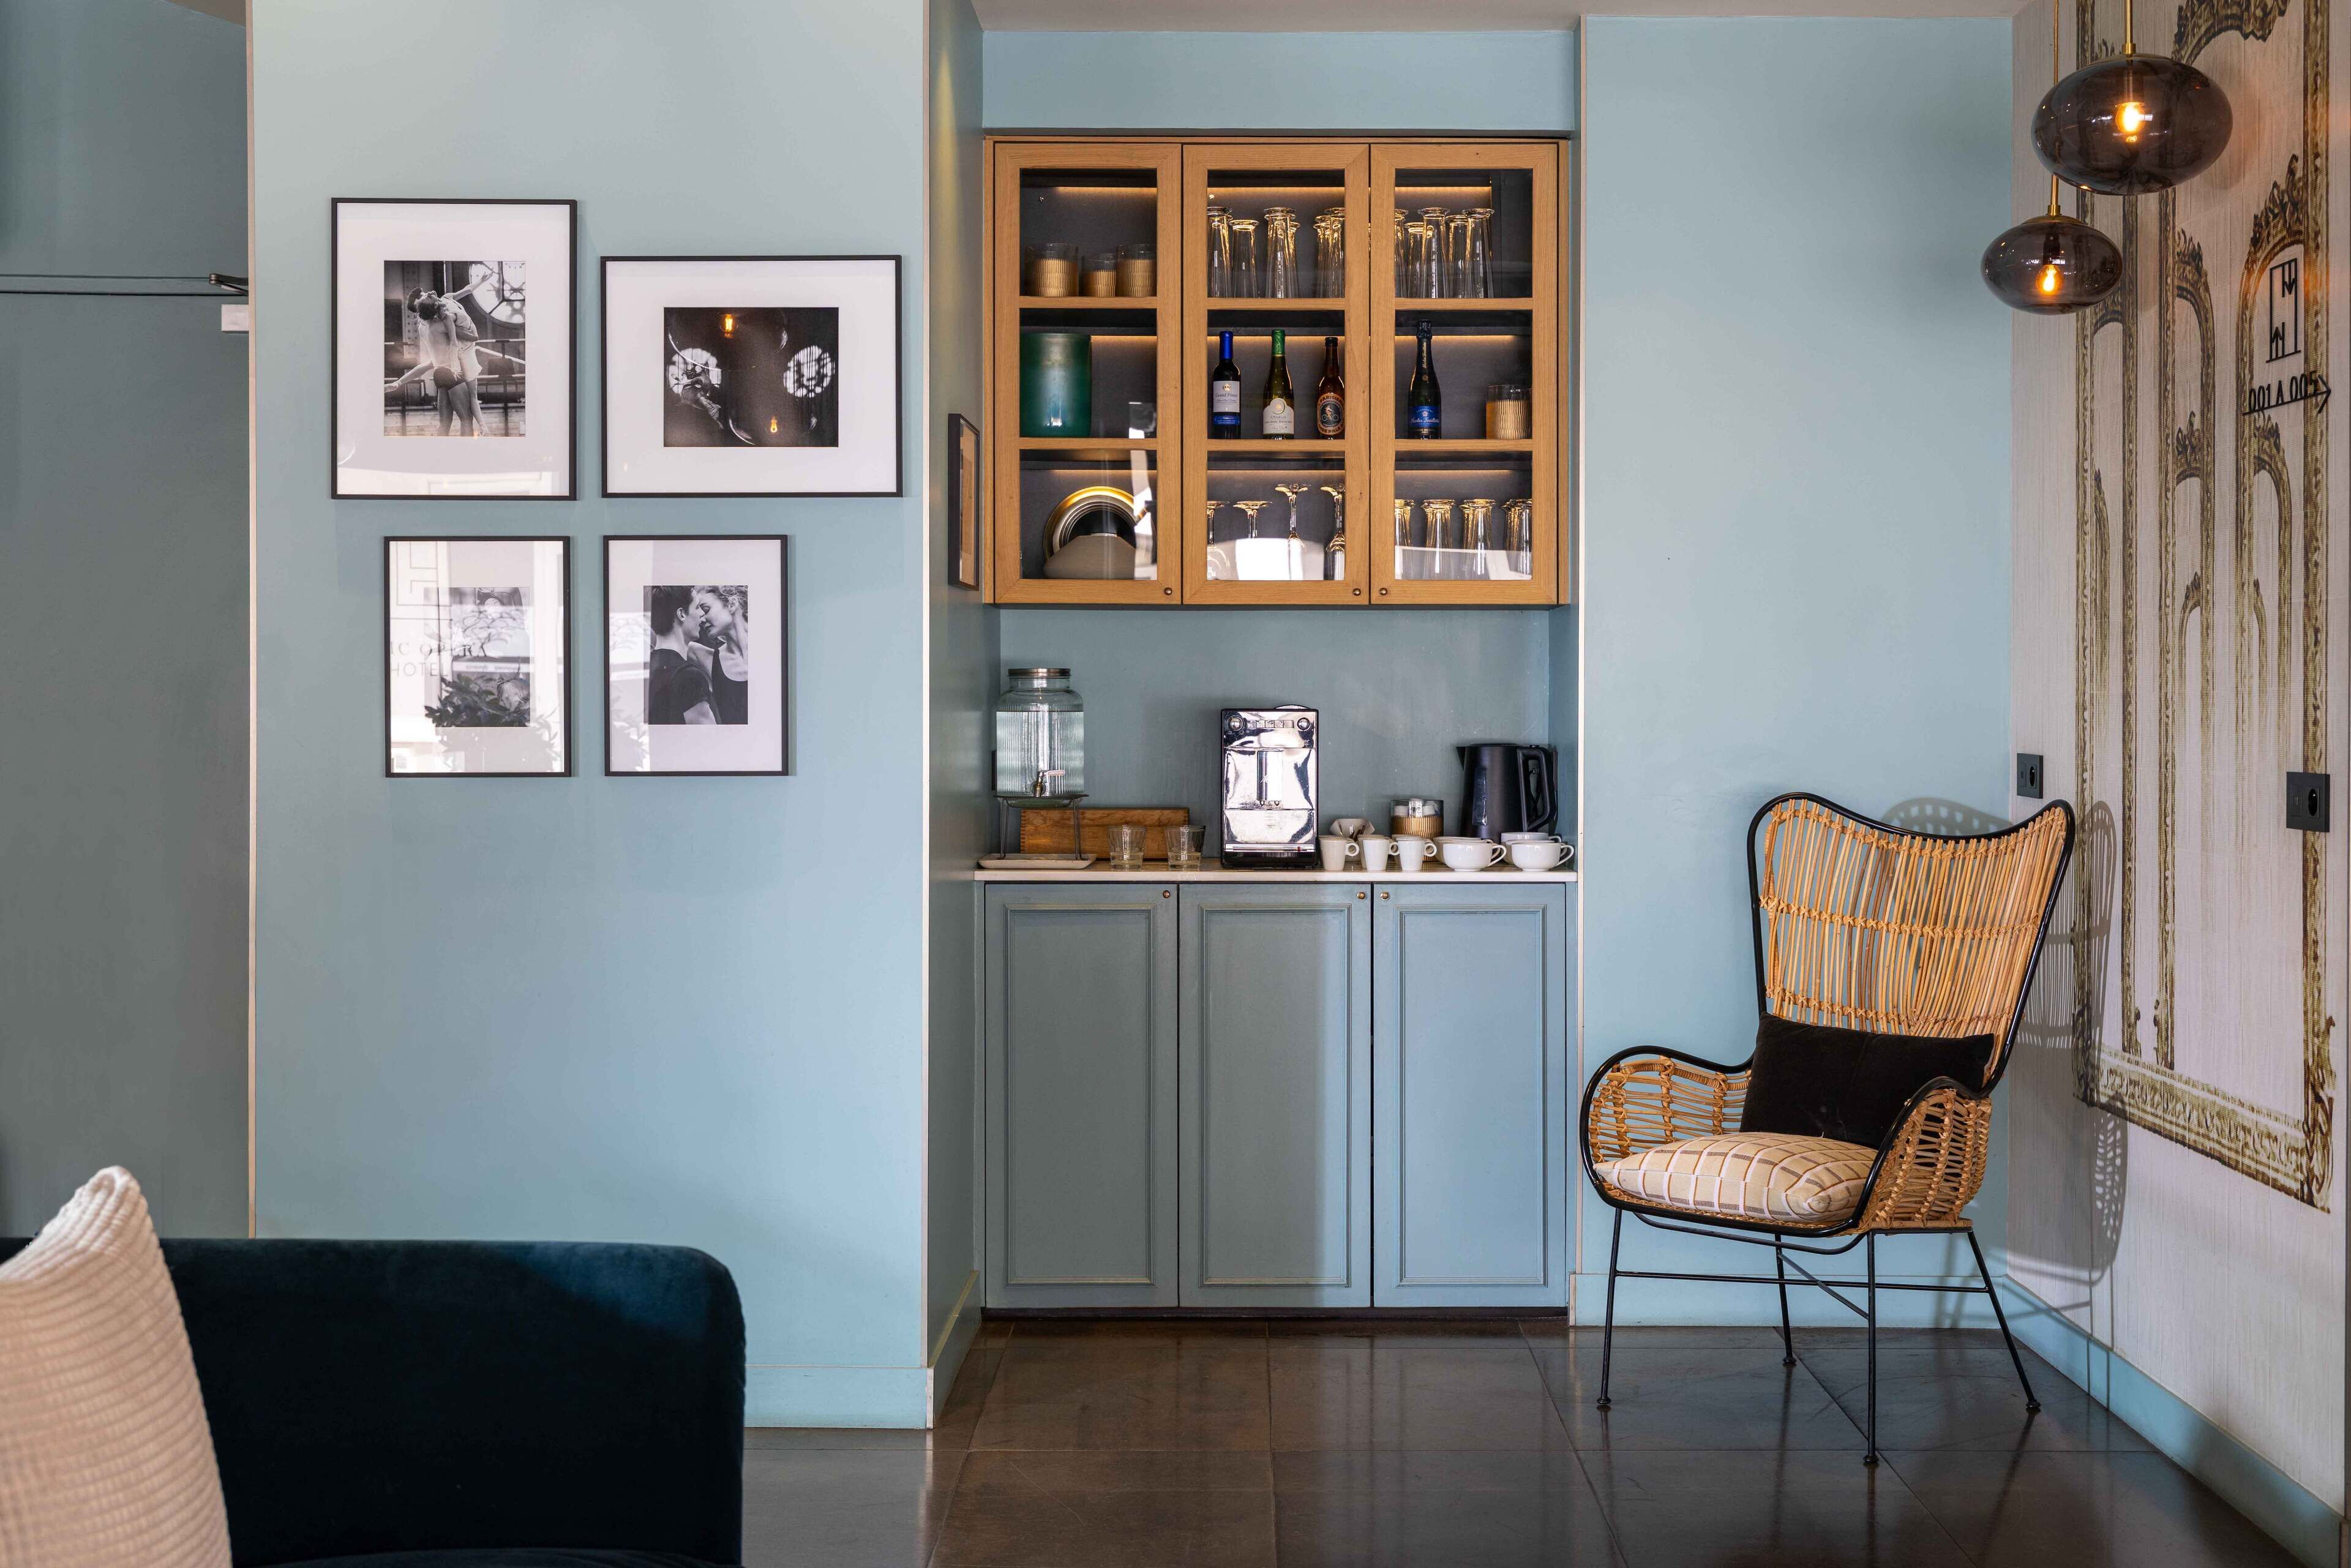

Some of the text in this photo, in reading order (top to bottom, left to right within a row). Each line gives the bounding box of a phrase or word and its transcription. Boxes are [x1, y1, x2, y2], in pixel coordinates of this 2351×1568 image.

[2249, 370, 2318, 411] 001 A 005
[420, 642, 487, 656] OPRA
